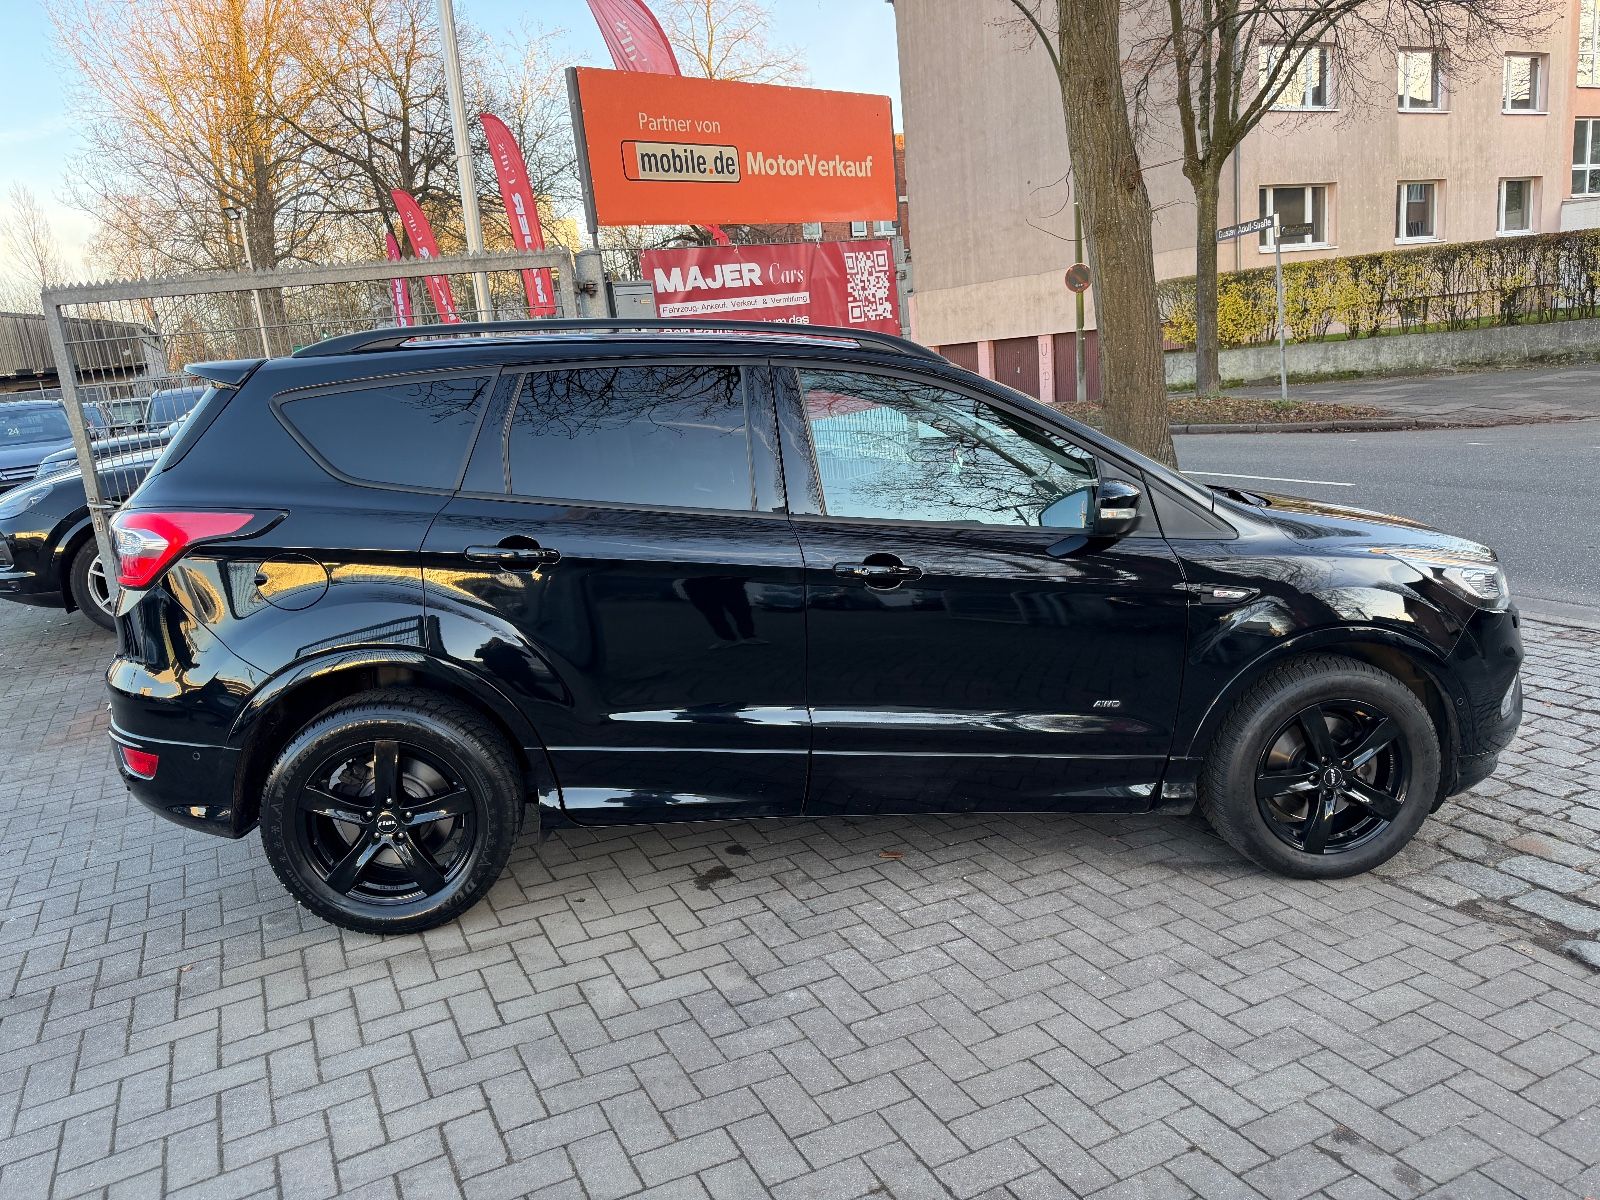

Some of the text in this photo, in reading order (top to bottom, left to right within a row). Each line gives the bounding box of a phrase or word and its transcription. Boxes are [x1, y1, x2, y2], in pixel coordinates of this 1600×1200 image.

[638, 112, 721, 134] Partner von
[640, 148, 736, 176] mobile.de
[746, 151, 873, 177] MotorVerkauf
[653, 262, 805, 293] MAJER Cars
